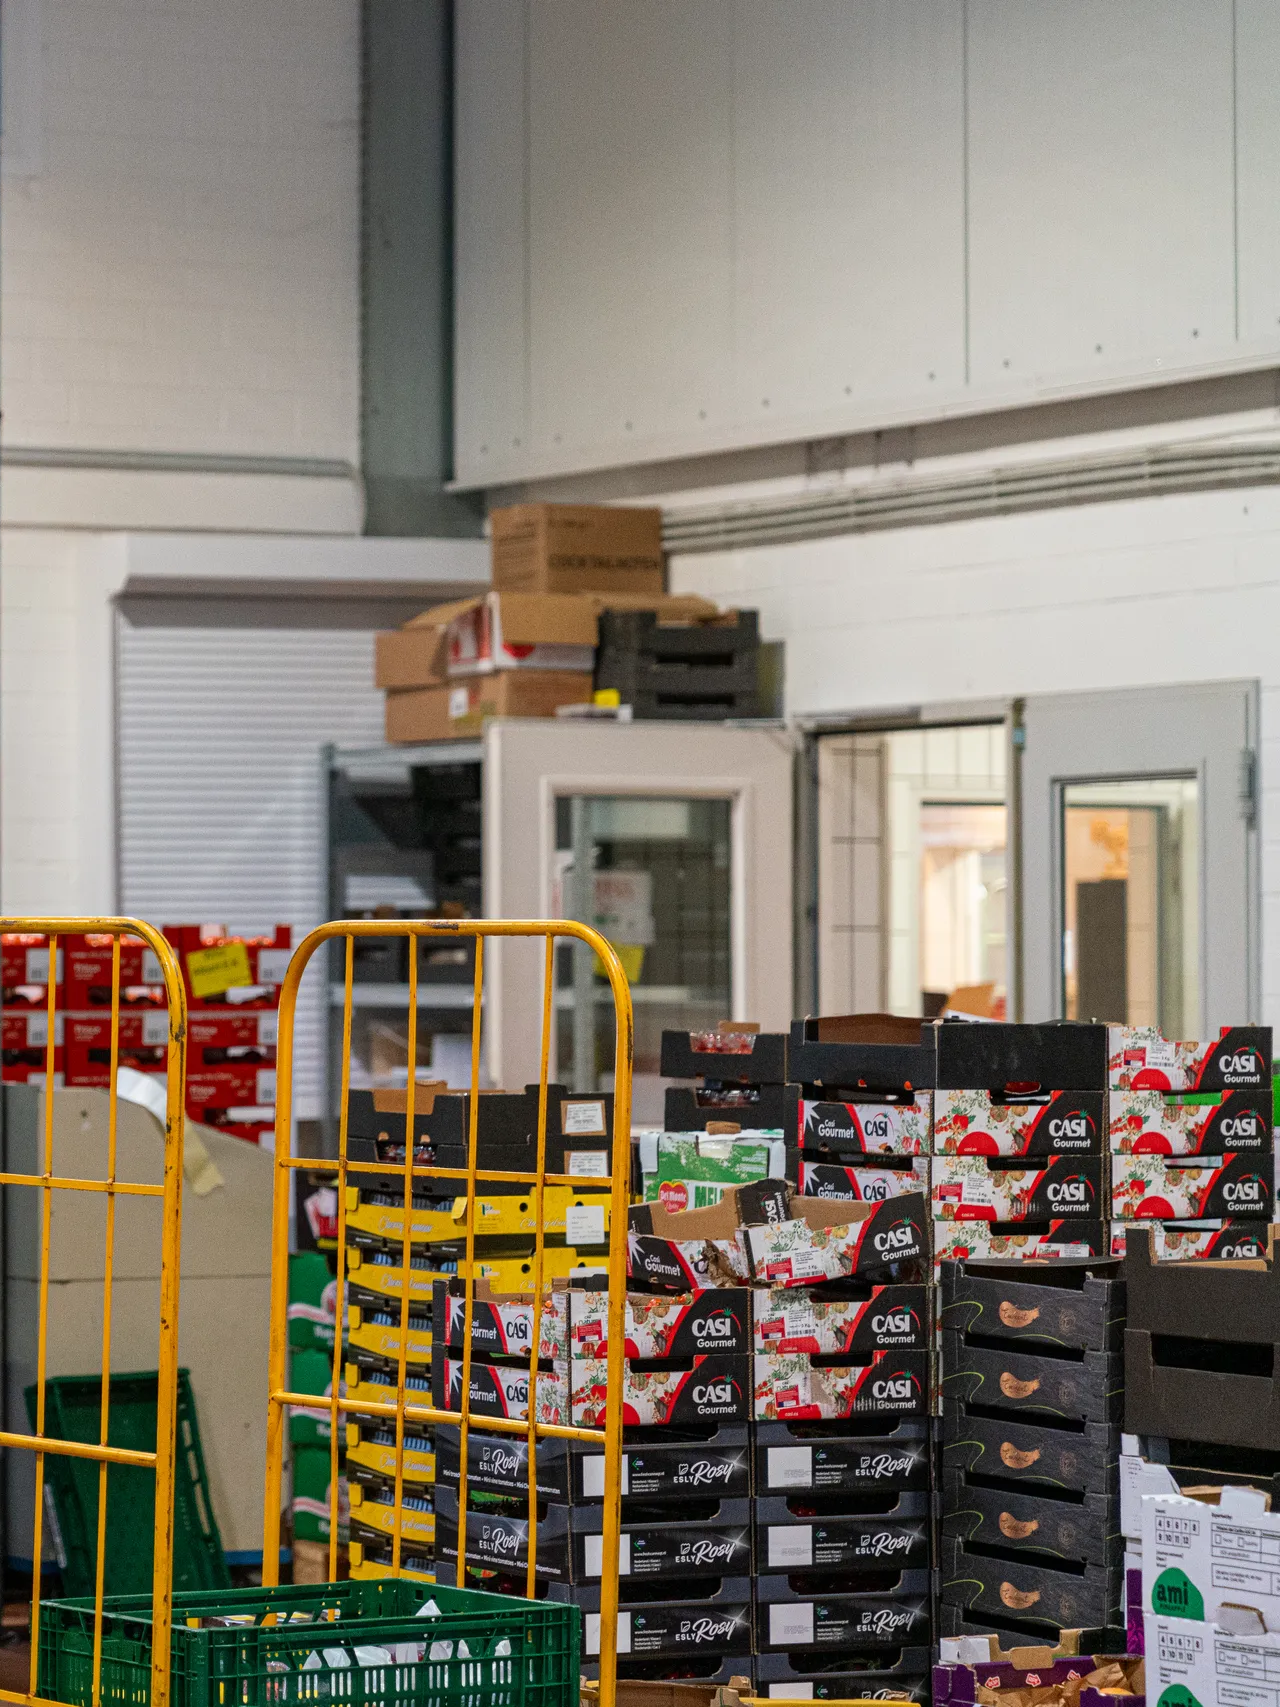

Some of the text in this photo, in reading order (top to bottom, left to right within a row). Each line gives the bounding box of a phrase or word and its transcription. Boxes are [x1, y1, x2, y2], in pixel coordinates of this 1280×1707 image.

[1219, 1055, 1256, 1073] CASI
[1224, 1074, 1260, 1083] Gourmet
[818, 1123, 855, 1139] Gourmet
[824, 1119, 836, 1127] Casi
[864, 1120, 888, 1137] CASI
[1049, 1119, 1086, 1137] CASI
[1220, 1118, 1257, 1136] CASI
[1053, 1138, 1091, 1148] Gourmet
[1225, 1138, 1261, 1146] Gourmet
[818, 1186, 854, 1200] Gourmet
[824, 1182, 835, 1190] Casi
[863, 1184, 887, 1201] CASI
[1047, 1183, 1085, 1201] CASI
[1222, 1183, 1259, 1200] CASI
[1052, 1203, 1090, 1212] Gourmet
[1227, 1202, 1264, 1211] Gourmet
[874, 1227, 914, 1251] CASI
[649, 1254, 661, 1263] Casi
[881, 1245, 920, 1261] Gourmet
[1221, 1245, 1257, 1258] CASI
[644, 1258, 681, 1277] Gourmet
[505, 1321, 528, 1340] CASI
[691, 1318, 731, 1337] CASI
[871, 1314, 911, 1333] CASI
[467, 1325, 497, 1340] ourmet
[876, 1334, 916, 1344] Gourmet
[697, 1338, 737, 1348] Gourmet
[469, 1390, 497, 1403] ourmet
[506, 1384, 528, 1404] CASI
[692, 1384, 732, 1404] CASI
[872, 1380, 912, 1399] CASI
[697, 1404, 737, 1415] Gourmet
[877, 1399, 917, 1410] Gourmet
[480, 1449, 520, 1477] ESLY Rosy
[872, 1454, 914, 1478] Rosy
[690, 1461, 734, 1486] Rosy
[479, 1528, 520, 1556] ESLY Rosy
[855, 1532, 914, 1557] ESLY Rosy
[692, 1540, 736, 1565] Rosy
[1157, 1581, 1189, 1606] ami
[1160, 1604, 1186, 1613] PINEAPPLE
[873, 1609, 915, 1634] Rosy
[692, 1618, 736, 1643] Rosy
